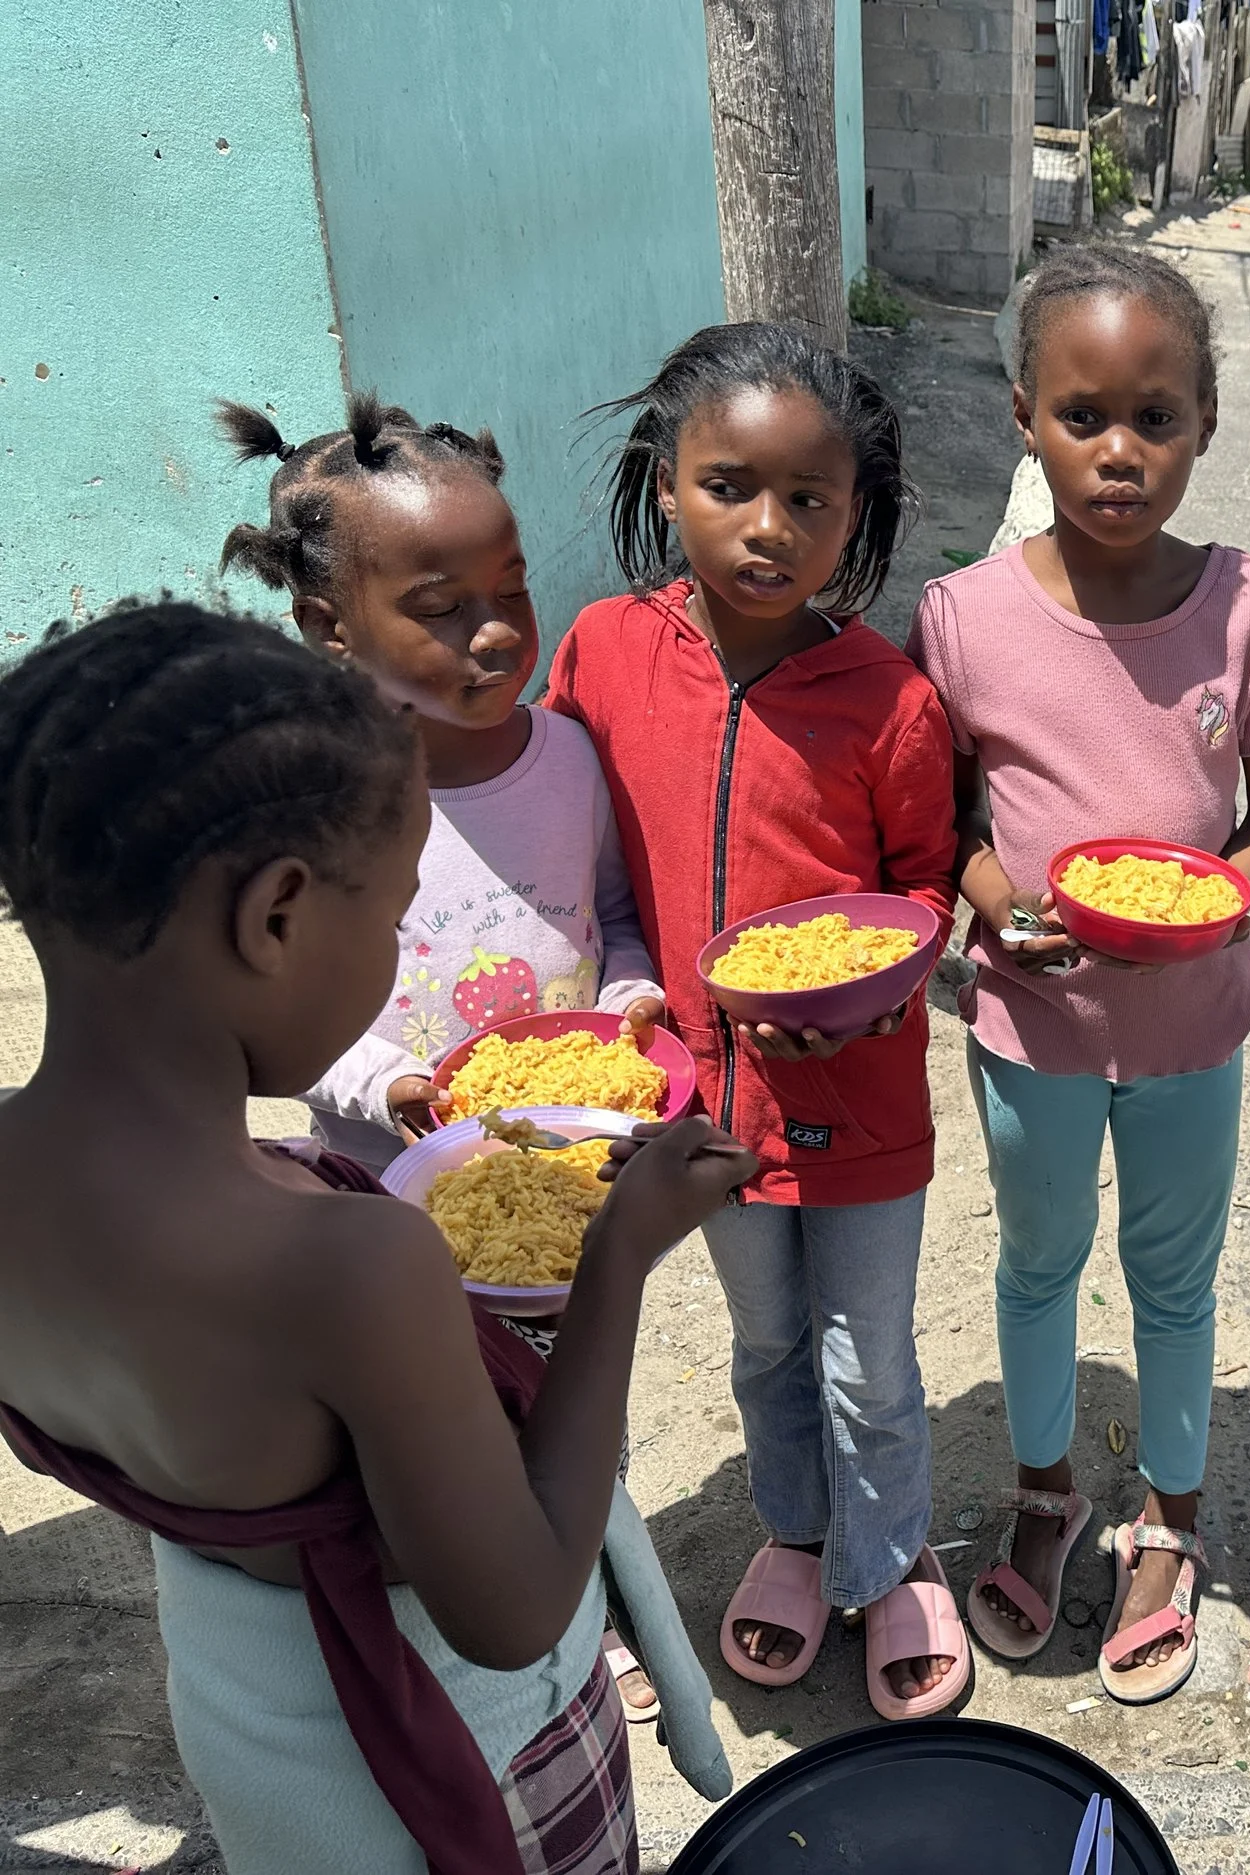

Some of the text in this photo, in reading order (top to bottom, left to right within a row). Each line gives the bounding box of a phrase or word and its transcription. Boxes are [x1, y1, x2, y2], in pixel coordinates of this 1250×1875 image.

[419, 880, 537, 935] Life is sweeter
[472, 899, 578, 935] with a friend
[790, 1128, 825, 1143] KDS
